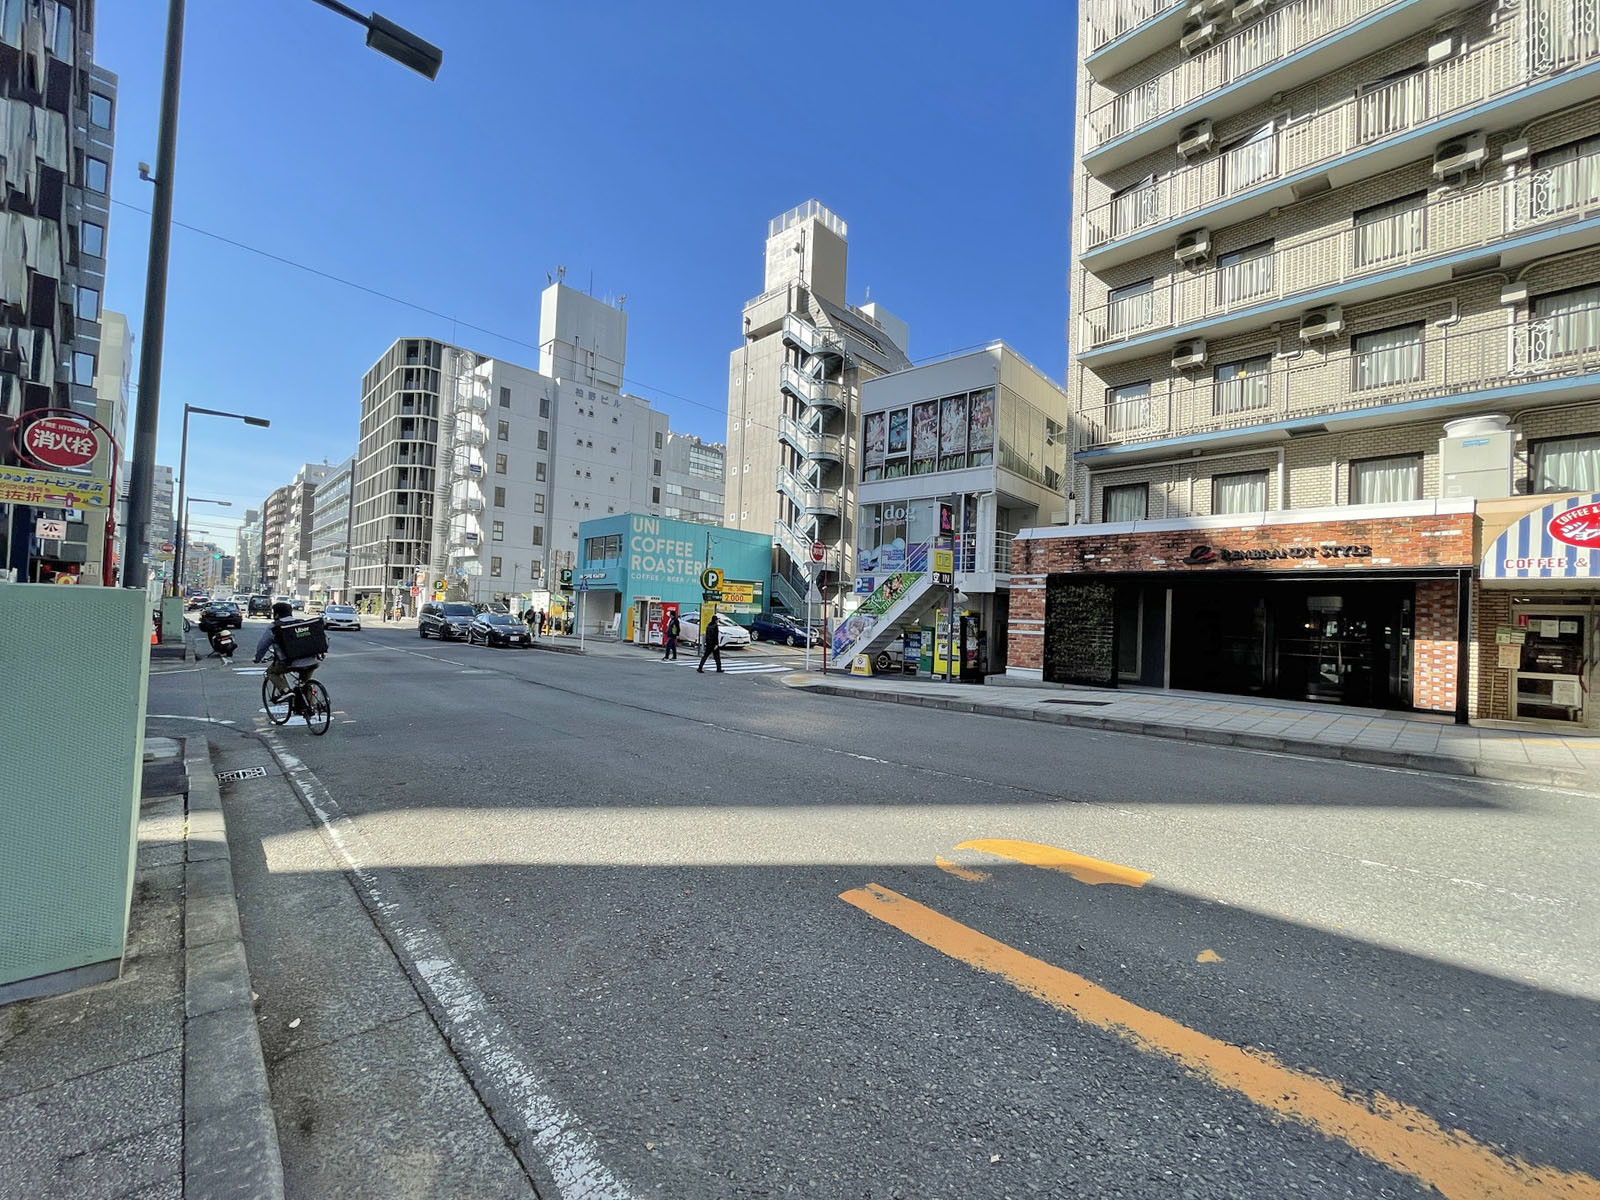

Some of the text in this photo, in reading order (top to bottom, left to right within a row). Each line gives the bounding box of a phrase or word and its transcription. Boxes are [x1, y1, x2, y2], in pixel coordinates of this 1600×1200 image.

[41, 421, 90, 434] FIRE HYDRANT
[32, 428, 94, 457] 消火栓
[884, 504, 916, 522] dog
[1556, 507, 1590, 526] COFFEE
[632, 516, 660, 536] UNI
[630, 535, 694, 558] COFFEE
[1220, 544, 1373, 561] REMBRANDT STYLE
[1504, 557, 1589, 569] COFFEE &
[563, 570, 572, 581] P
[708, 572, 718, 587] P
[942, 573, 950, 583] IN
[436, 581, 443, 589] P
[294, 626, 310, 634] Uber
